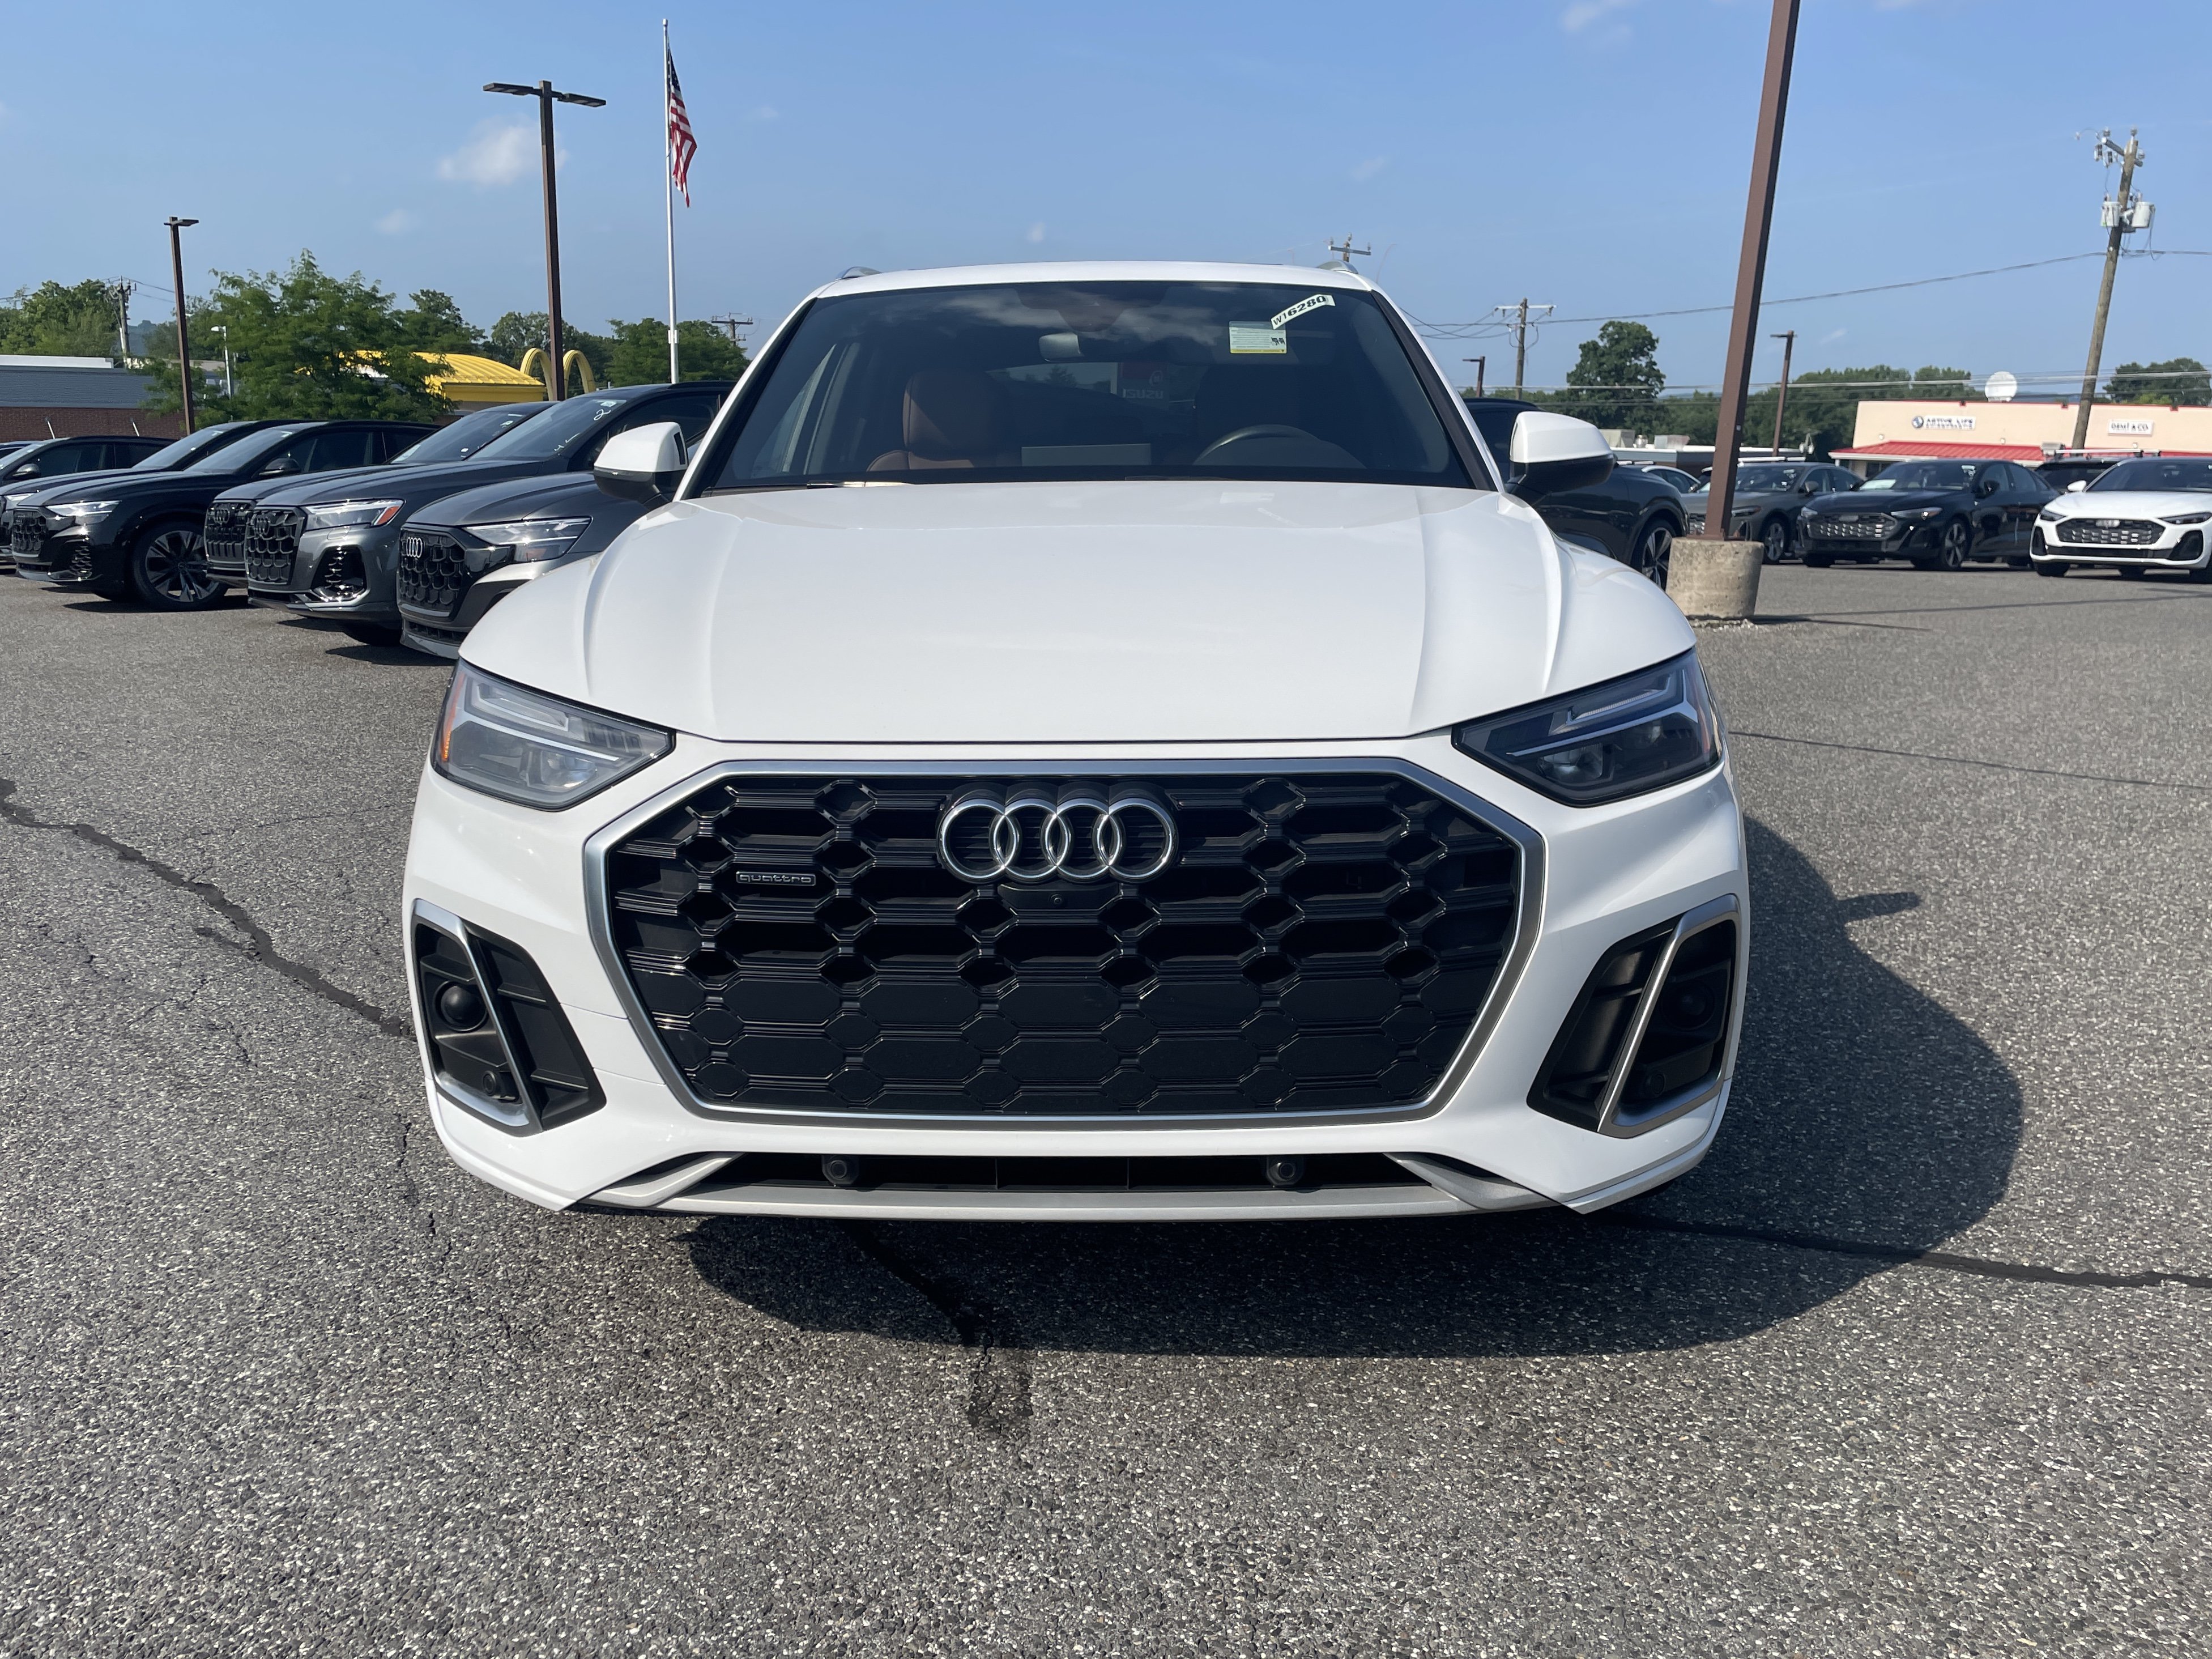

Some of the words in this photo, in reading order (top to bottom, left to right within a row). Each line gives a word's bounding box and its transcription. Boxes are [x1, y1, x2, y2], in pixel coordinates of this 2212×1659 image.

[1273, 296, 1327, 325] W16280
[1123, 389, 1163, 399] ISUZU
[738, 873, 813, 884] quattro
